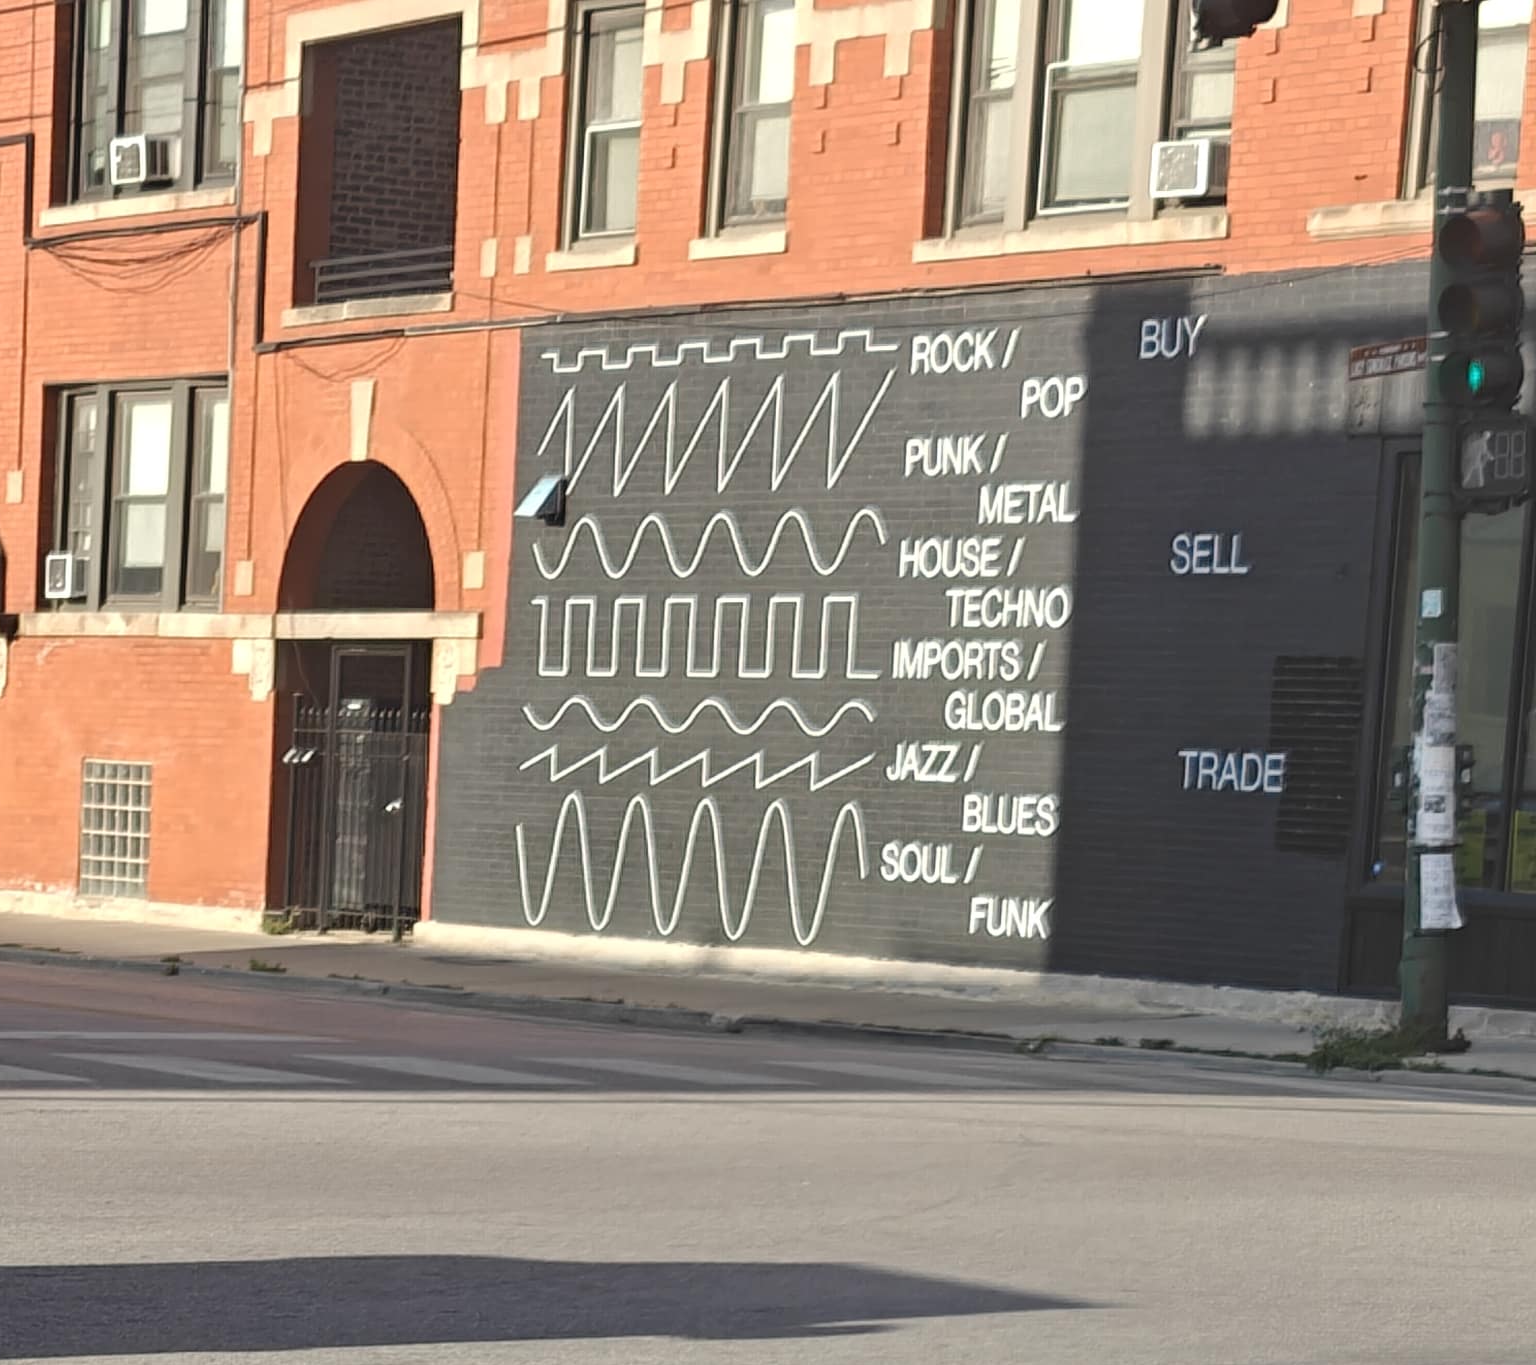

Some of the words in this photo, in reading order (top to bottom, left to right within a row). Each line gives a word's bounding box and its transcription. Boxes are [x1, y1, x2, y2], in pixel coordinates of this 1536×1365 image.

[910, 327, 998, 375] ROCK
[1138, 314, 1208, 361] BUY
[1020, 375, 1089, 420] POP
[904, 433, 987, 478] PUNK
[977, 480, 1080, 525] METAL
[898, 536, 1002, 579] HOUSE
[1170, 532, 1251, 576] SELL
[945, 584, 1074, 630] TECHNO
[891, 638, 1020, 682] IMPORTS
[944, 688, 1064, 732] GLOBAL
[886, 740, 962, 783] JAZZ
[1177, 749, 1288, 794] TRADE
[962, 793, 1062, 837] BLUES
[880, 841, 961, 884] SOUL
[968, 896, 1054, 940] FUNK
